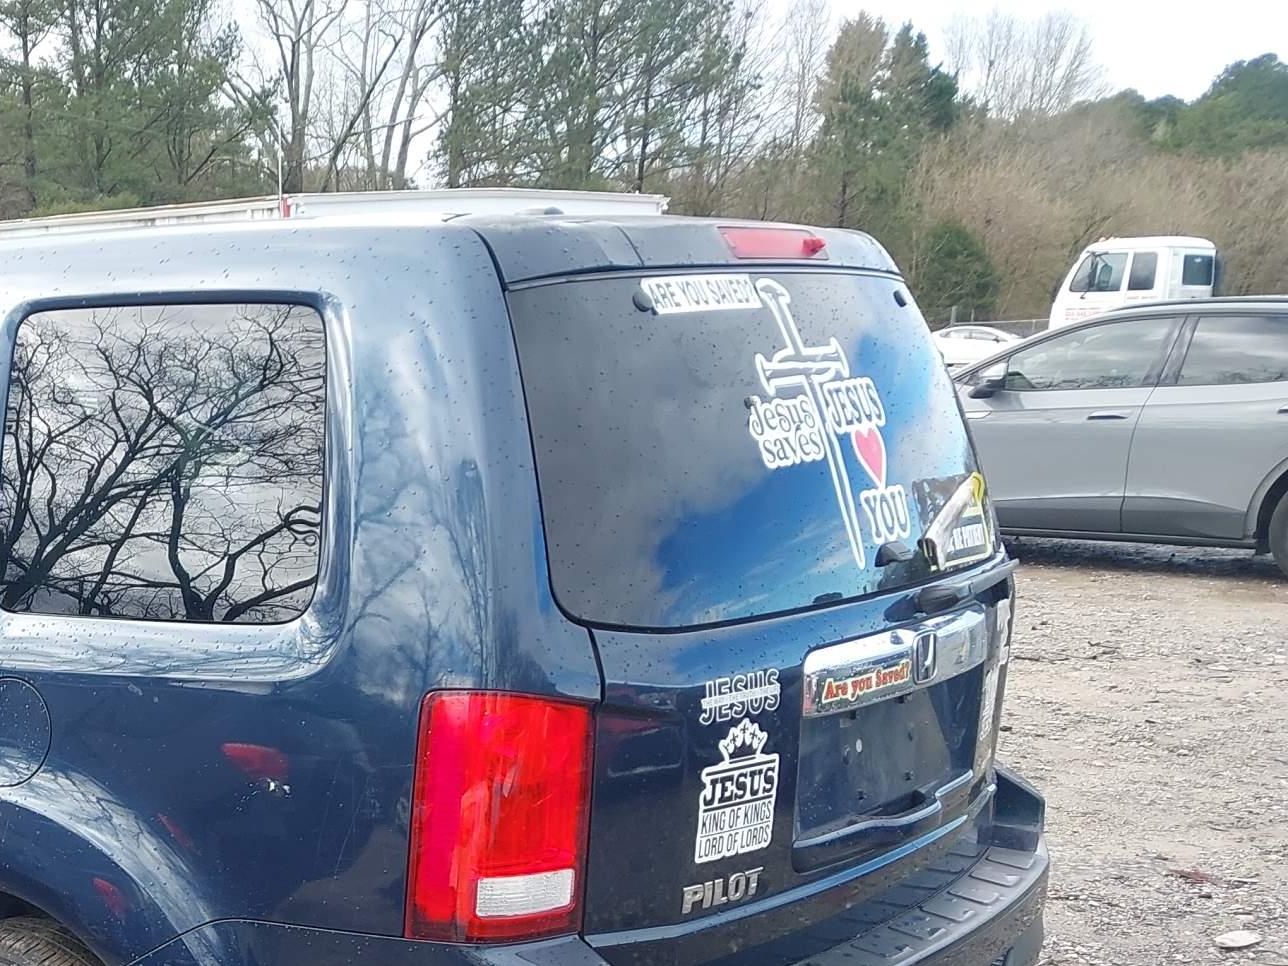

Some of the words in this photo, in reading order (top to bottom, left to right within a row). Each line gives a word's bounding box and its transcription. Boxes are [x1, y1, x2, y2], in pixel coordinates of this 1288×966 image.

[648, 281, 681, 308] ARE
[675, 280, 709, 306] YOU
[751, 398, 816, 436] Jesus
[826, 381, 883, 428] JESUS
[763, 425, 821, 463] saves
[864, 489, 909, 538] YOU
[699, 668, 781, 725] JESUS
[823, 680, 849, 700] Are
[851, 675, 873, 698] you
[875, 661, 911, 687] Saved?
[703, 765, 776, 807] JESUS
[701, 811, 726, 835] KING
[728, 807, 741, 829] OF
[743, 800, 772, 826] KINGS
[698, 835, 724, 858] LORD
[726, 832, 739, 852] OF
[740, 824, 770, 848] LORDS
[682, 866, 764, 914] PILOT
